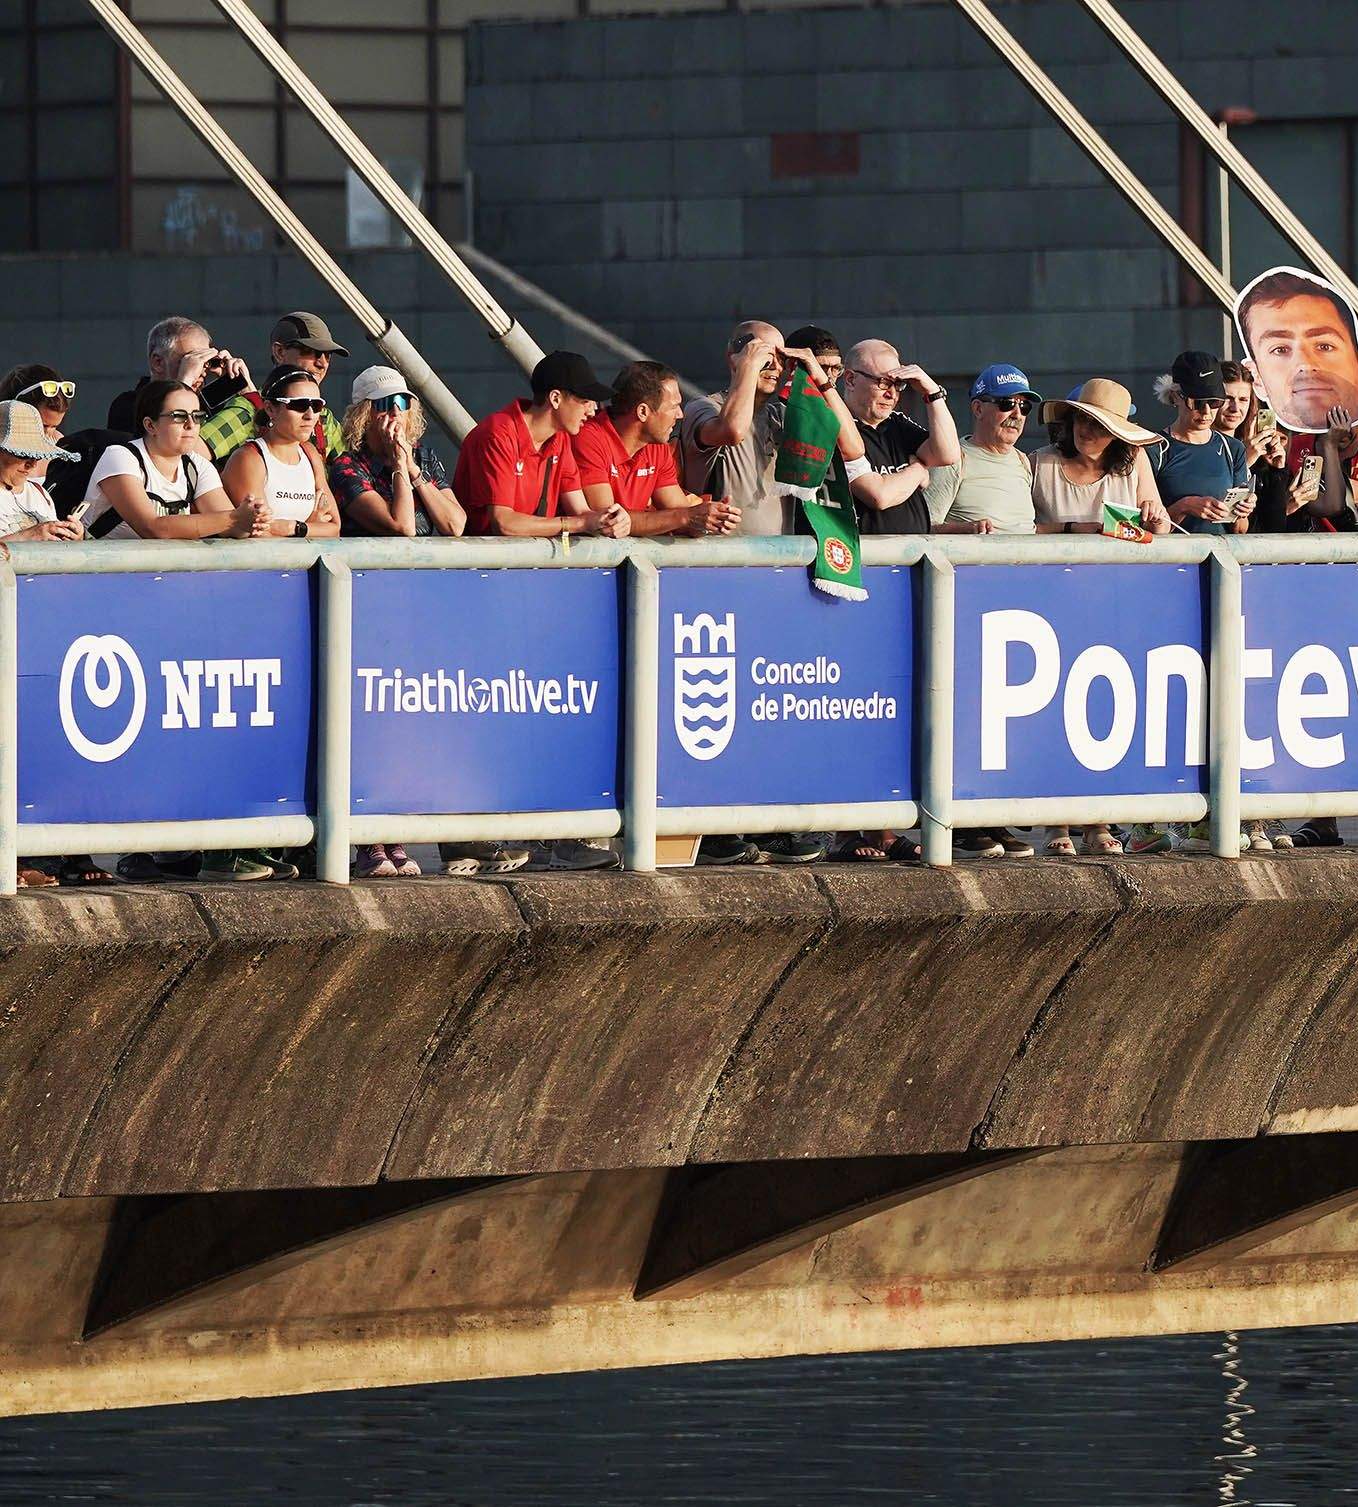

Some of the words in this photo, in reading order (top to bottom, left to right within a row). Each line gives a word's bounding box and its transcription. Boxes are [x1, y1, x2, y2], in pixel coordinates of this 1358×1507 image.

[751, 656, 840, 685] Concello
[161, 659, 281, 729] NTT
[357, 667, 599, 715] Triathlonlive.tv
[751, 692, 779, 721] de
[782, 692, 896, 721] Pontevedra
